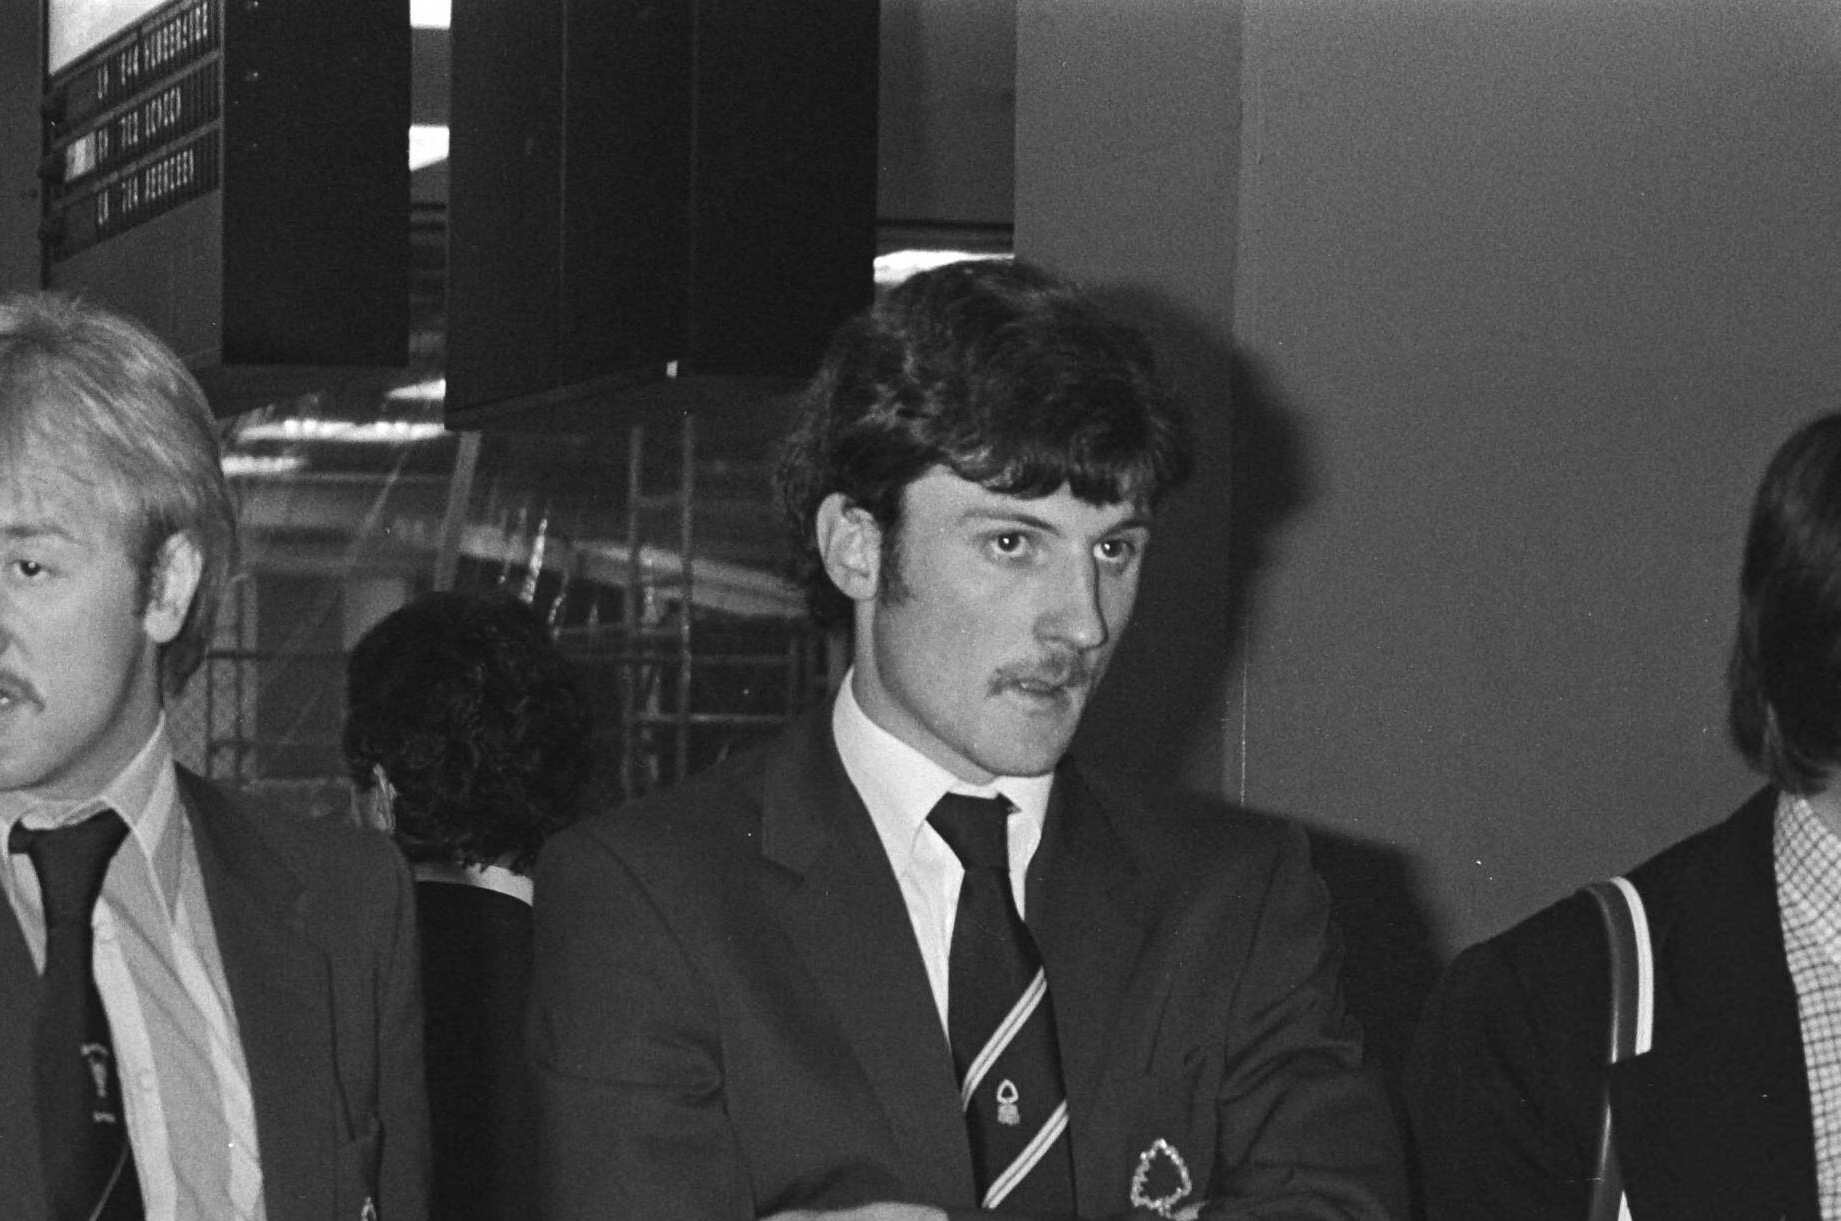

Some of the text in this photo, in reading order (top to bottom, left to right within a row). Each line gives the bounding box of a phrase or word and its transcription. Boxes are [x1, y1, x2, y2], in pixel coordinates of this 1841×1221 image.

[143, 1, 208, 72] HUMBERSIDE
[144, 85, 182, 138] LONDON
[144, 148, 195, 203] ABERDEEN
